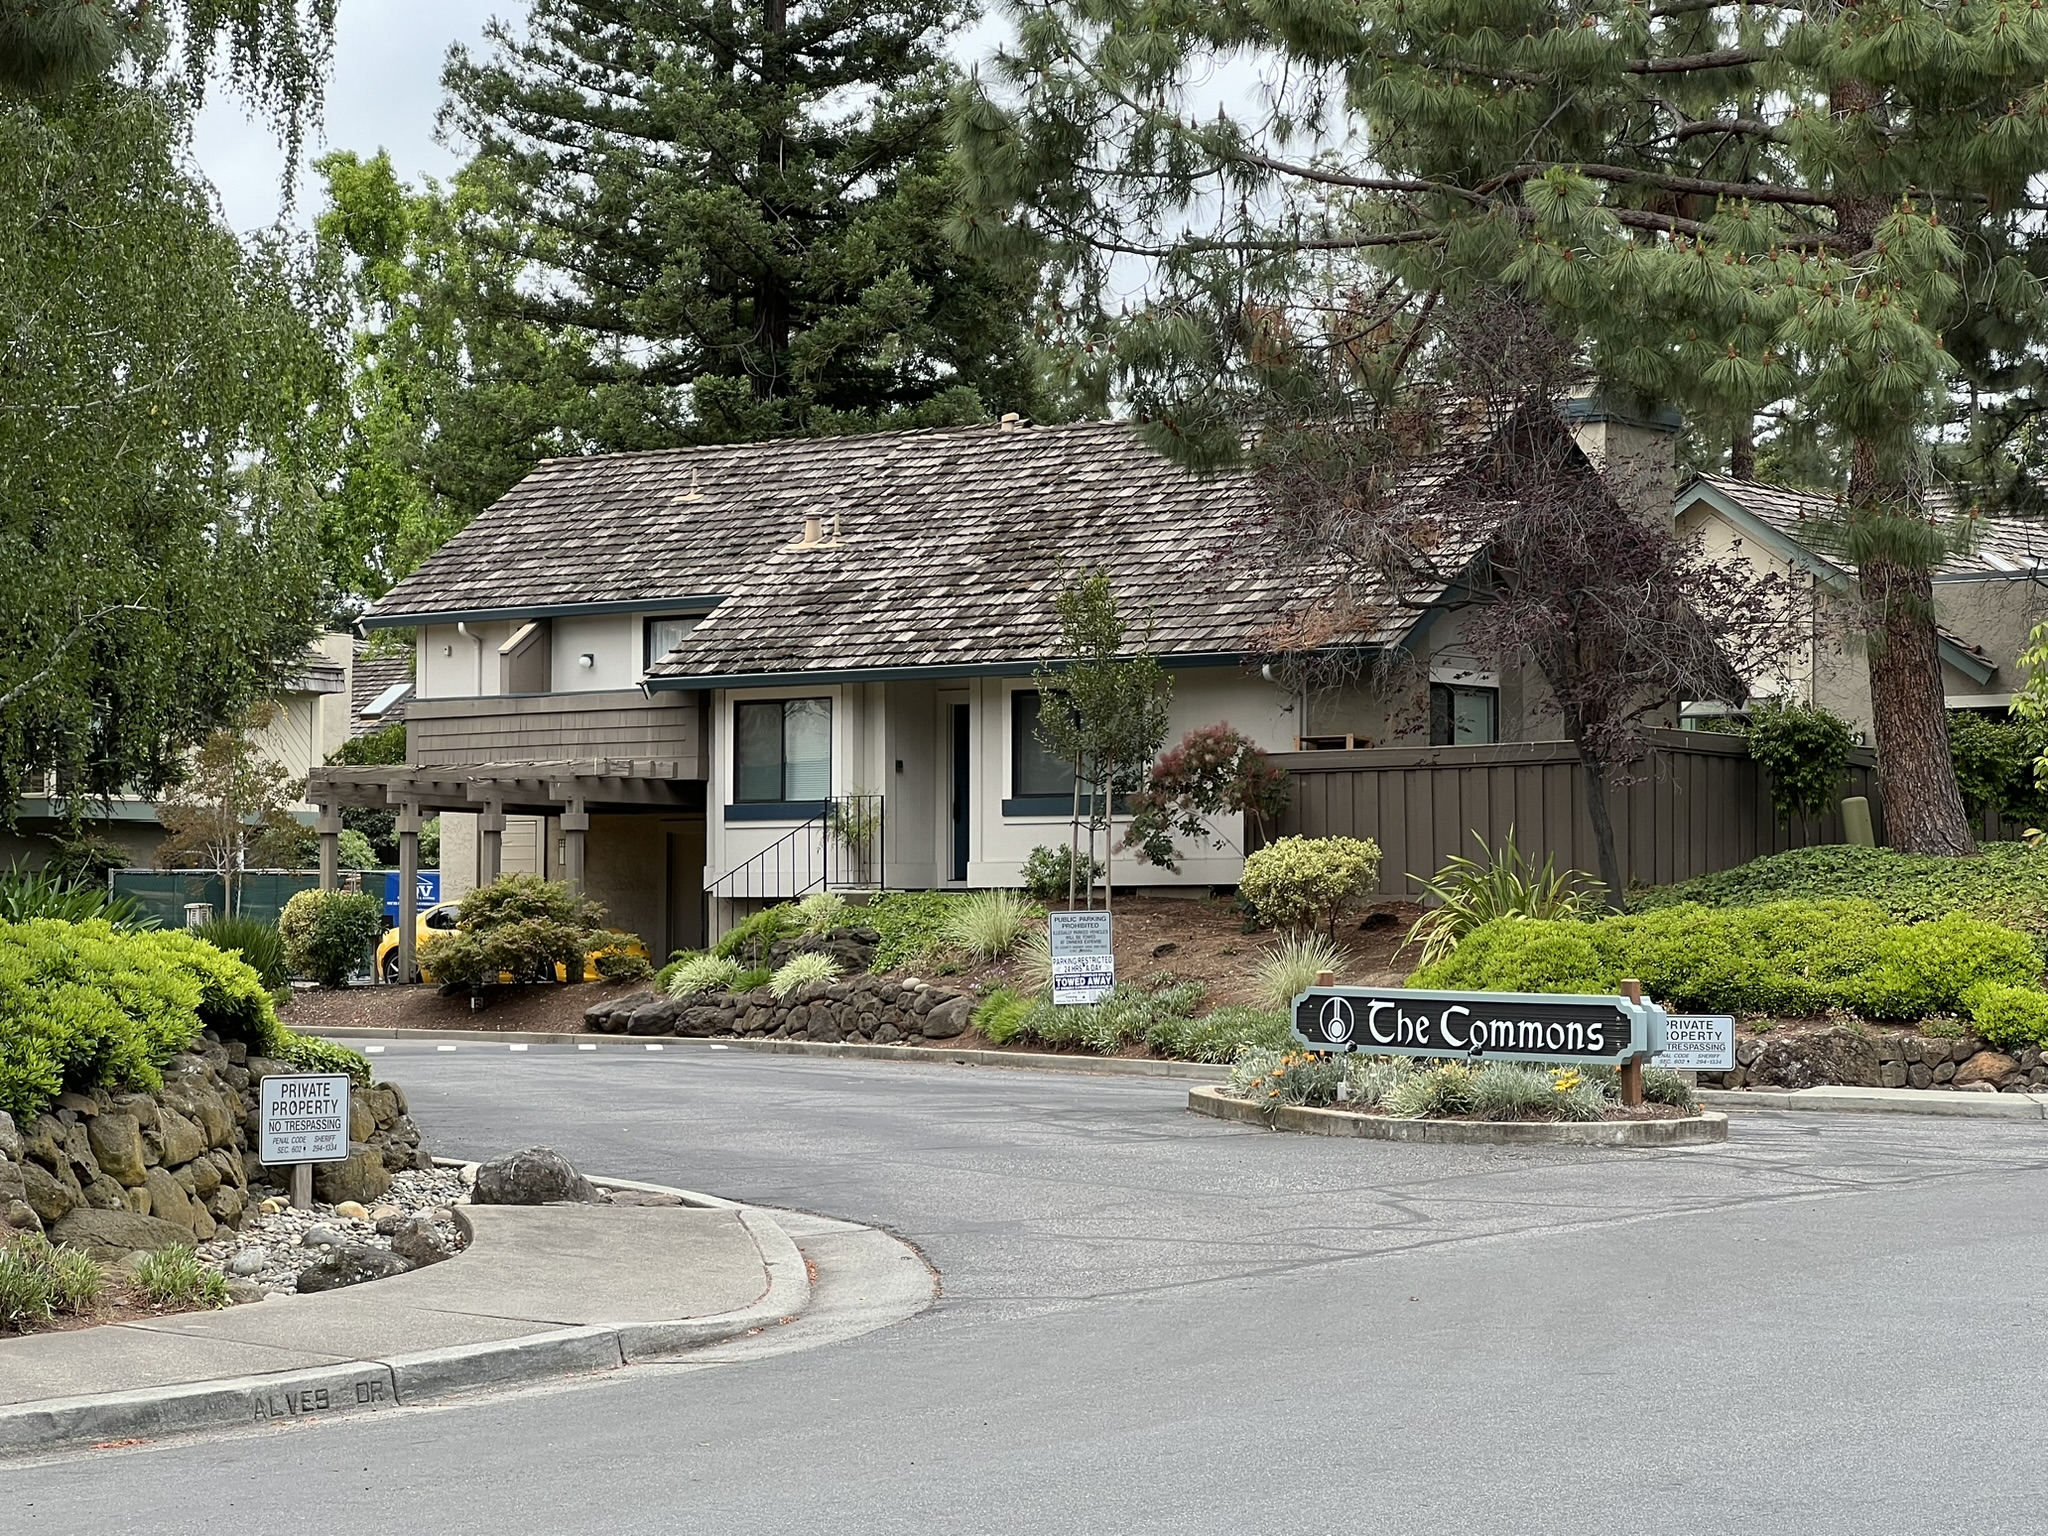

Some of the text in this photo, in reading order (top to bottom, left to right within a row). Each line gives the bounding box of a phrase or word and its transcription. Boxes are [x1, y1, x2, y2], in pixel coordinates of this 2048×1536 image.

[1053, 956, 1113, 965] PARKING RESTRICTED
[1064, 965, 1071, 973] 24
[1055, 976, 1111, 986] TOWED AWAY
[1367, 998, 1604, 1051] The Commons
[1666, 1030, 1722, 1041] OPERTY
[1667, 1043, 1726, 1051] TRESPASSING
[281, 1082, 331, 1098] PRIVATE
[272, 1099, 338, 1116] PROPERTY
[268, 1118, 342, 1132] NO TRESPASSING
[272, 1134, 337, 1145] PENAL CODE SHERIFF
[291, 1145, 302, 1154] 602
[312, 1144, 338, 1153] 294-1334
[254, 1381, 384, 1420] ALVES DR
